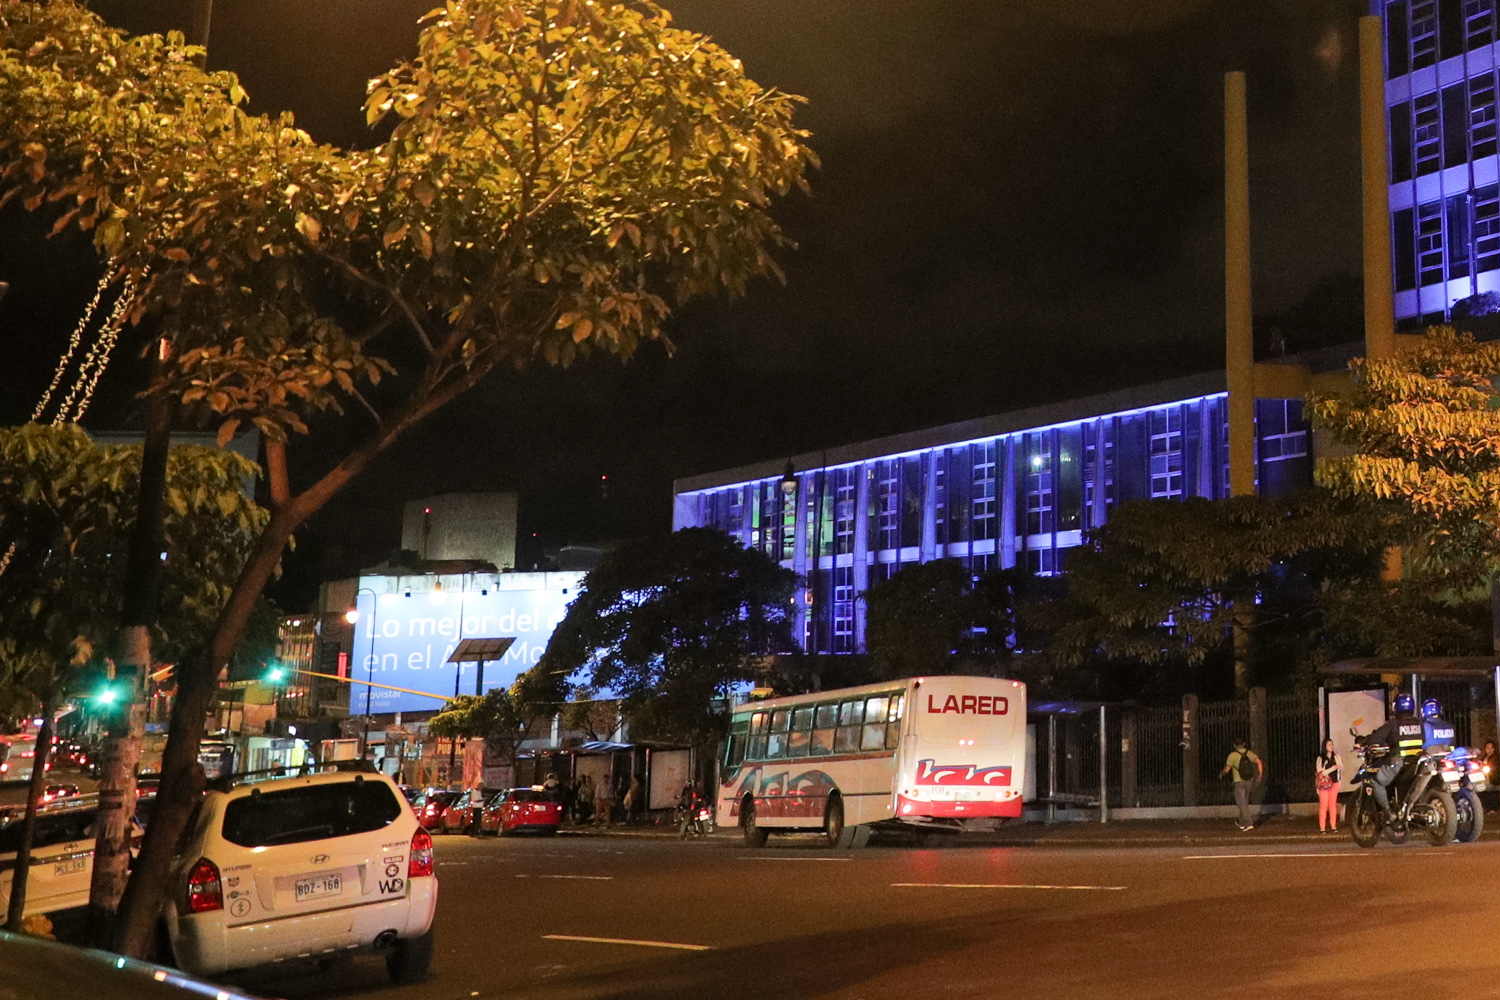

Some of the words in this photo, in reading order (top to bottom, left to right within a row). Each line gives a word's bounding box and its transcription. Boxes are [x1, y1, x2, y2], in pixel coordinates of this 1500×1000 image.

[366, 613, 400, 639] Lo
[409, 611, 492, 642] mejor
[498, 608, 539, 633] del
[363, 652, 398, 672] en
[407, 645, 431, 670] el
[928, 694, 1009, 716] LARED
[298, 878, 340, 896] BDZ-168
